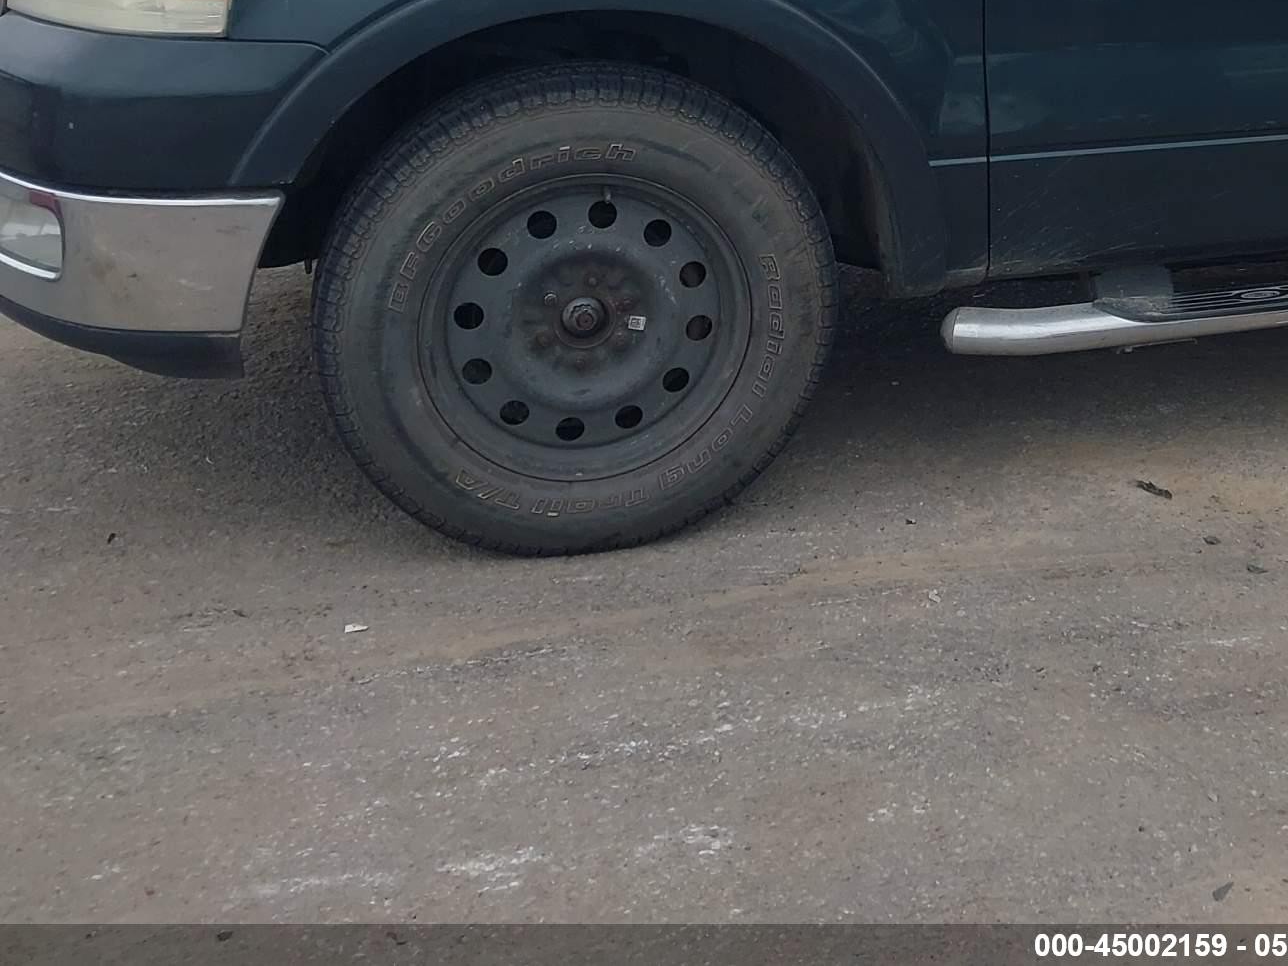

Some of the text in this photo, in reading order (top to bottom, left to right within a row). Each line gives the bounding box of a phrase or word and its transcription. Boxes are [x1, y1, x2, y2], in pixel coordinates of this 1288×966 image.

[387, 142, 637, 314] BFGoodrich
[455, 253, 786, 517] Radial Long Trail T/A
